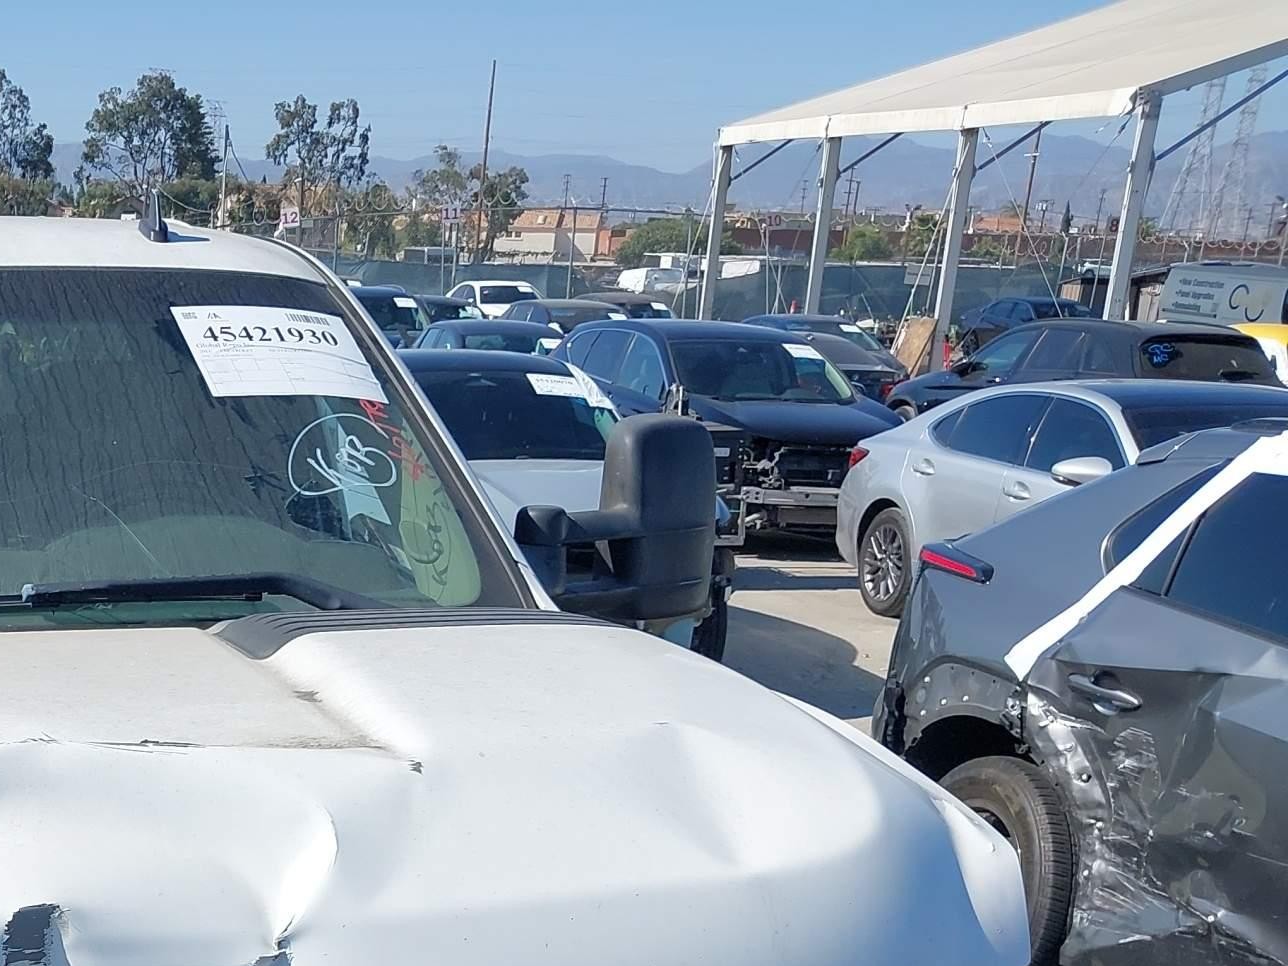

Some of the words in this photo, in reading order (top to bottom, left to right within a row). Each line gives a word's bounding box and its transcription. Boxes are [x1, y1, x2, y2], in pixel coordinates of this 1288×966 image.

[282, 212, 298, 225] 12
[443, 208, 458, 220] 11
[767, 214, 781, 227] 10
[1109, 218, 1119, 232] 8
[203, 325, 339, 347] 45421930
